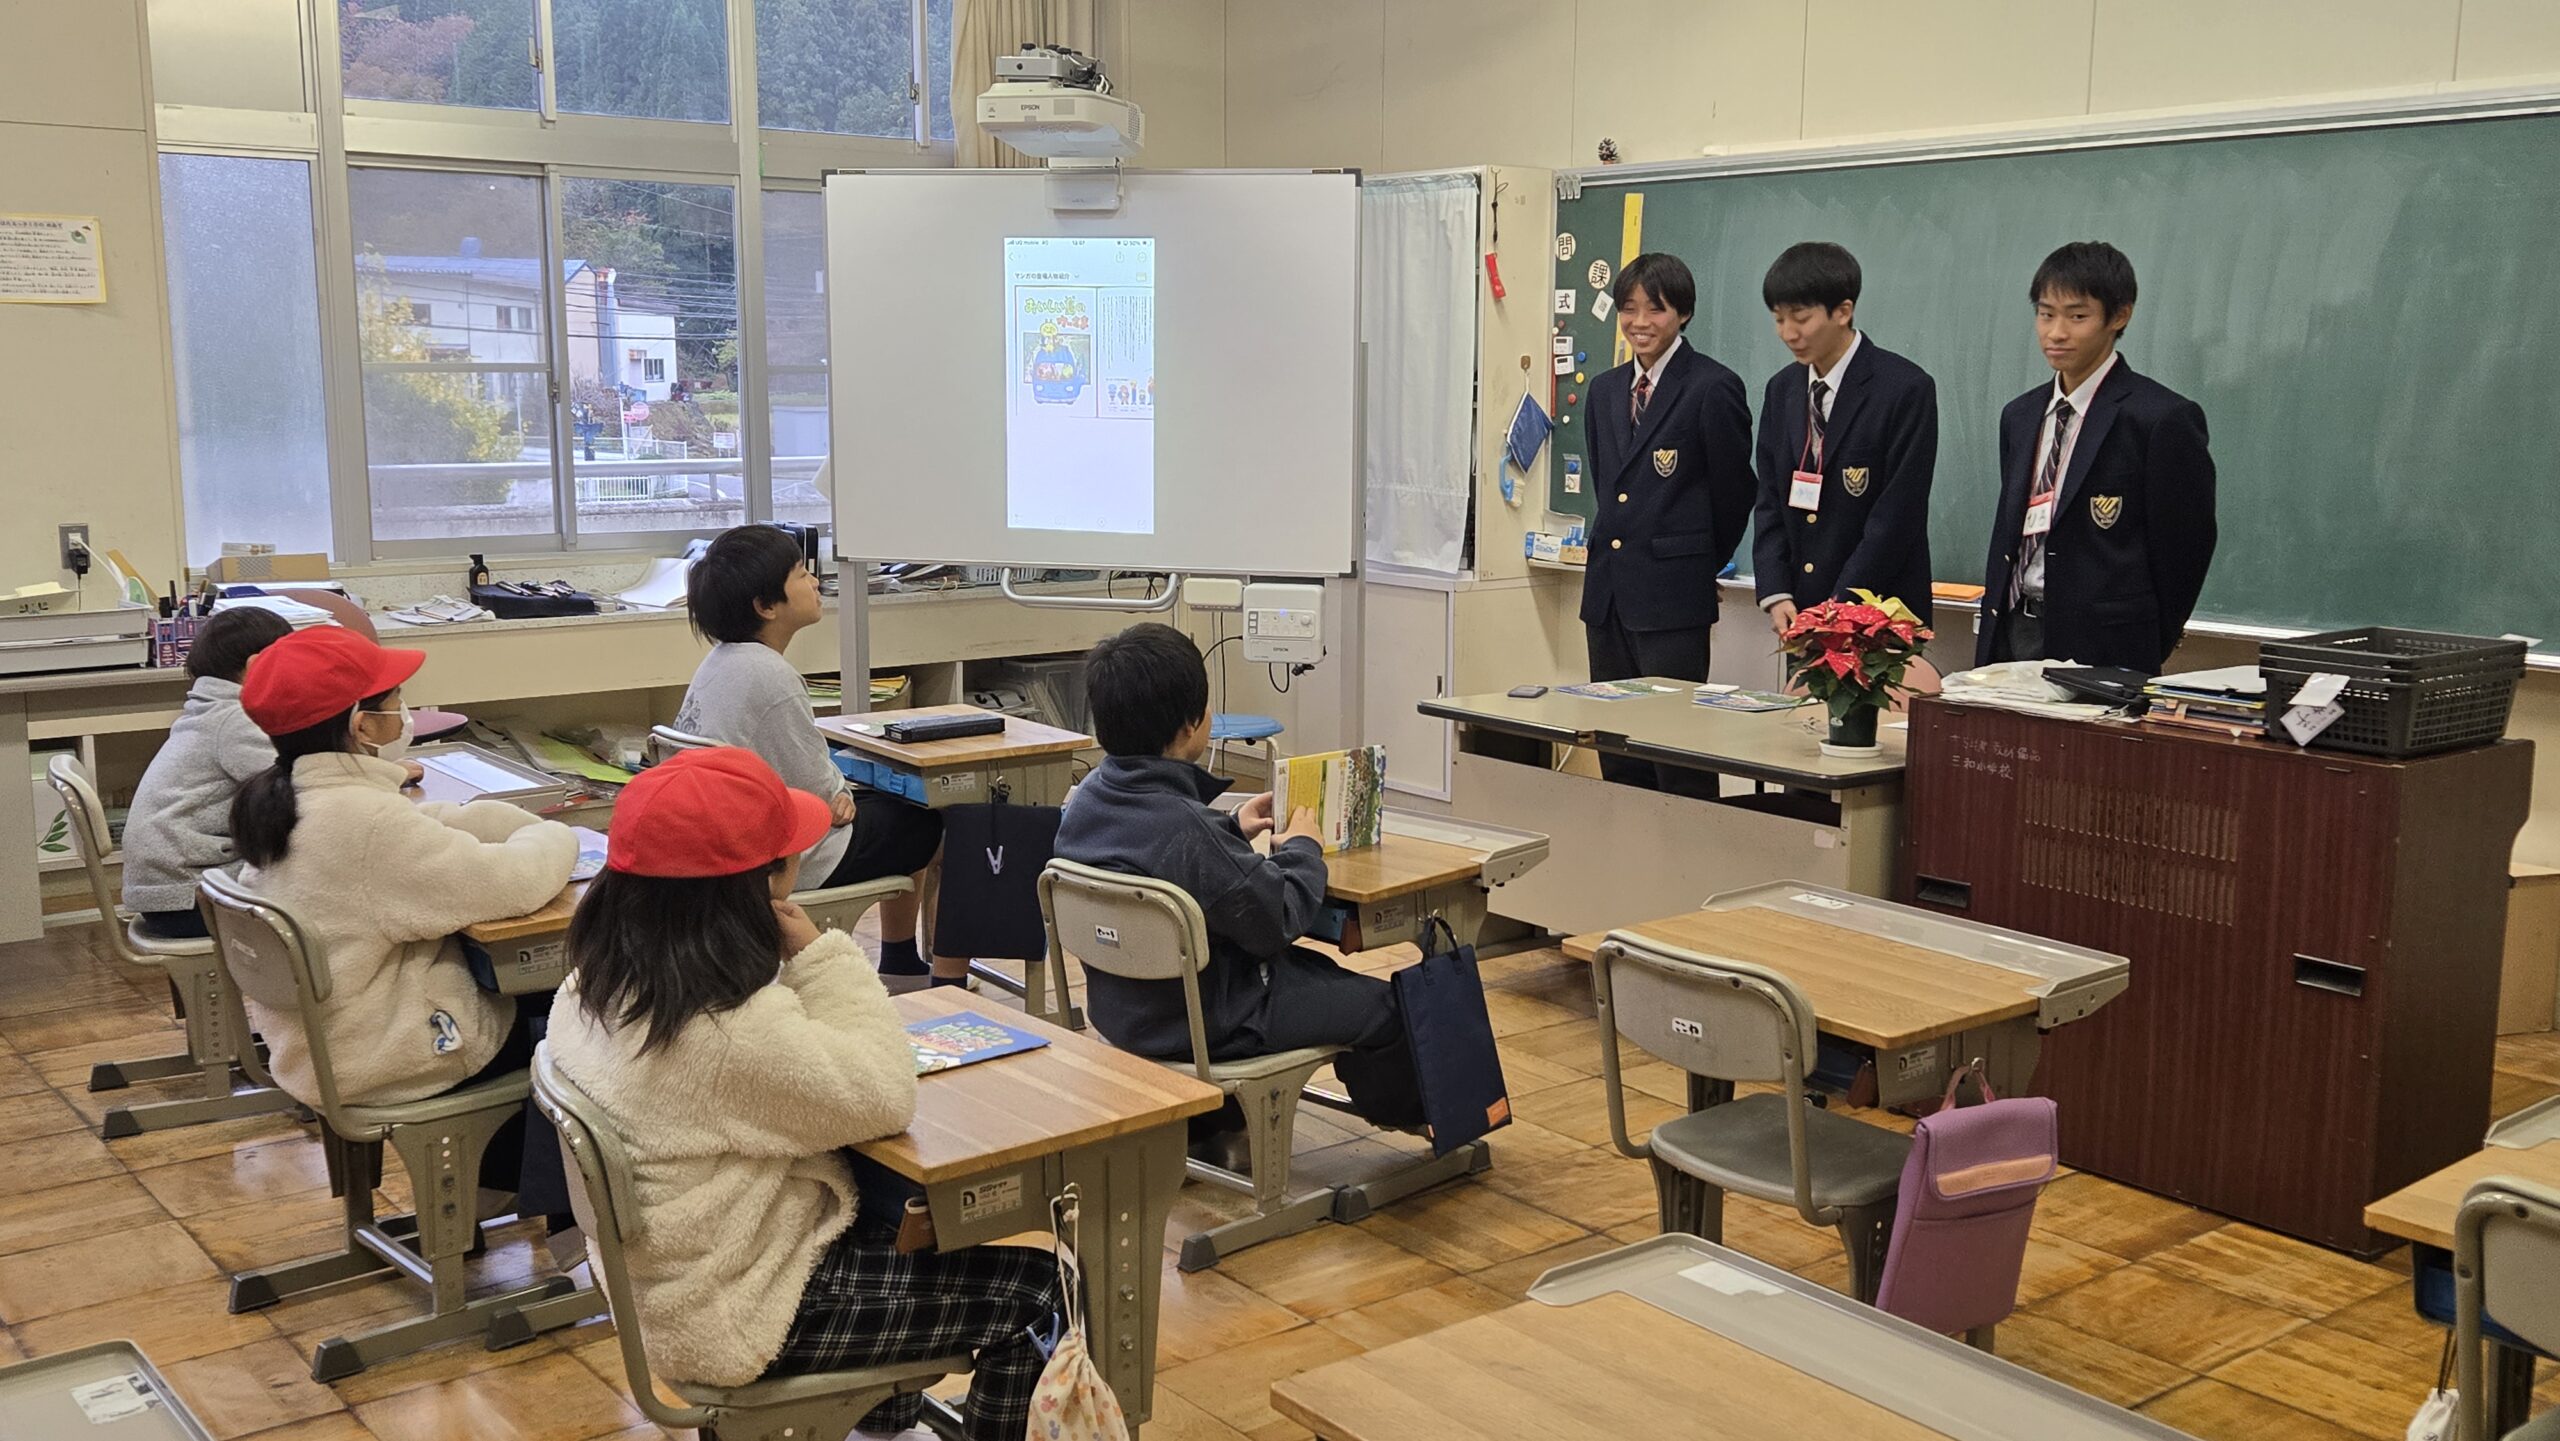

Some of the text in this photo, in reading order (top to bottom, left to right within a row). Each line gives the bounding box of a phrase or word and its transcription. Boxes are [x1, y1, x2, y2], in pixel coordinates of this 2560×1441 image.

[1558, 235, 1573, 258] 問
[1590, 262, 1608, 286] 課
[1558, 292, 1570, 310] 式
